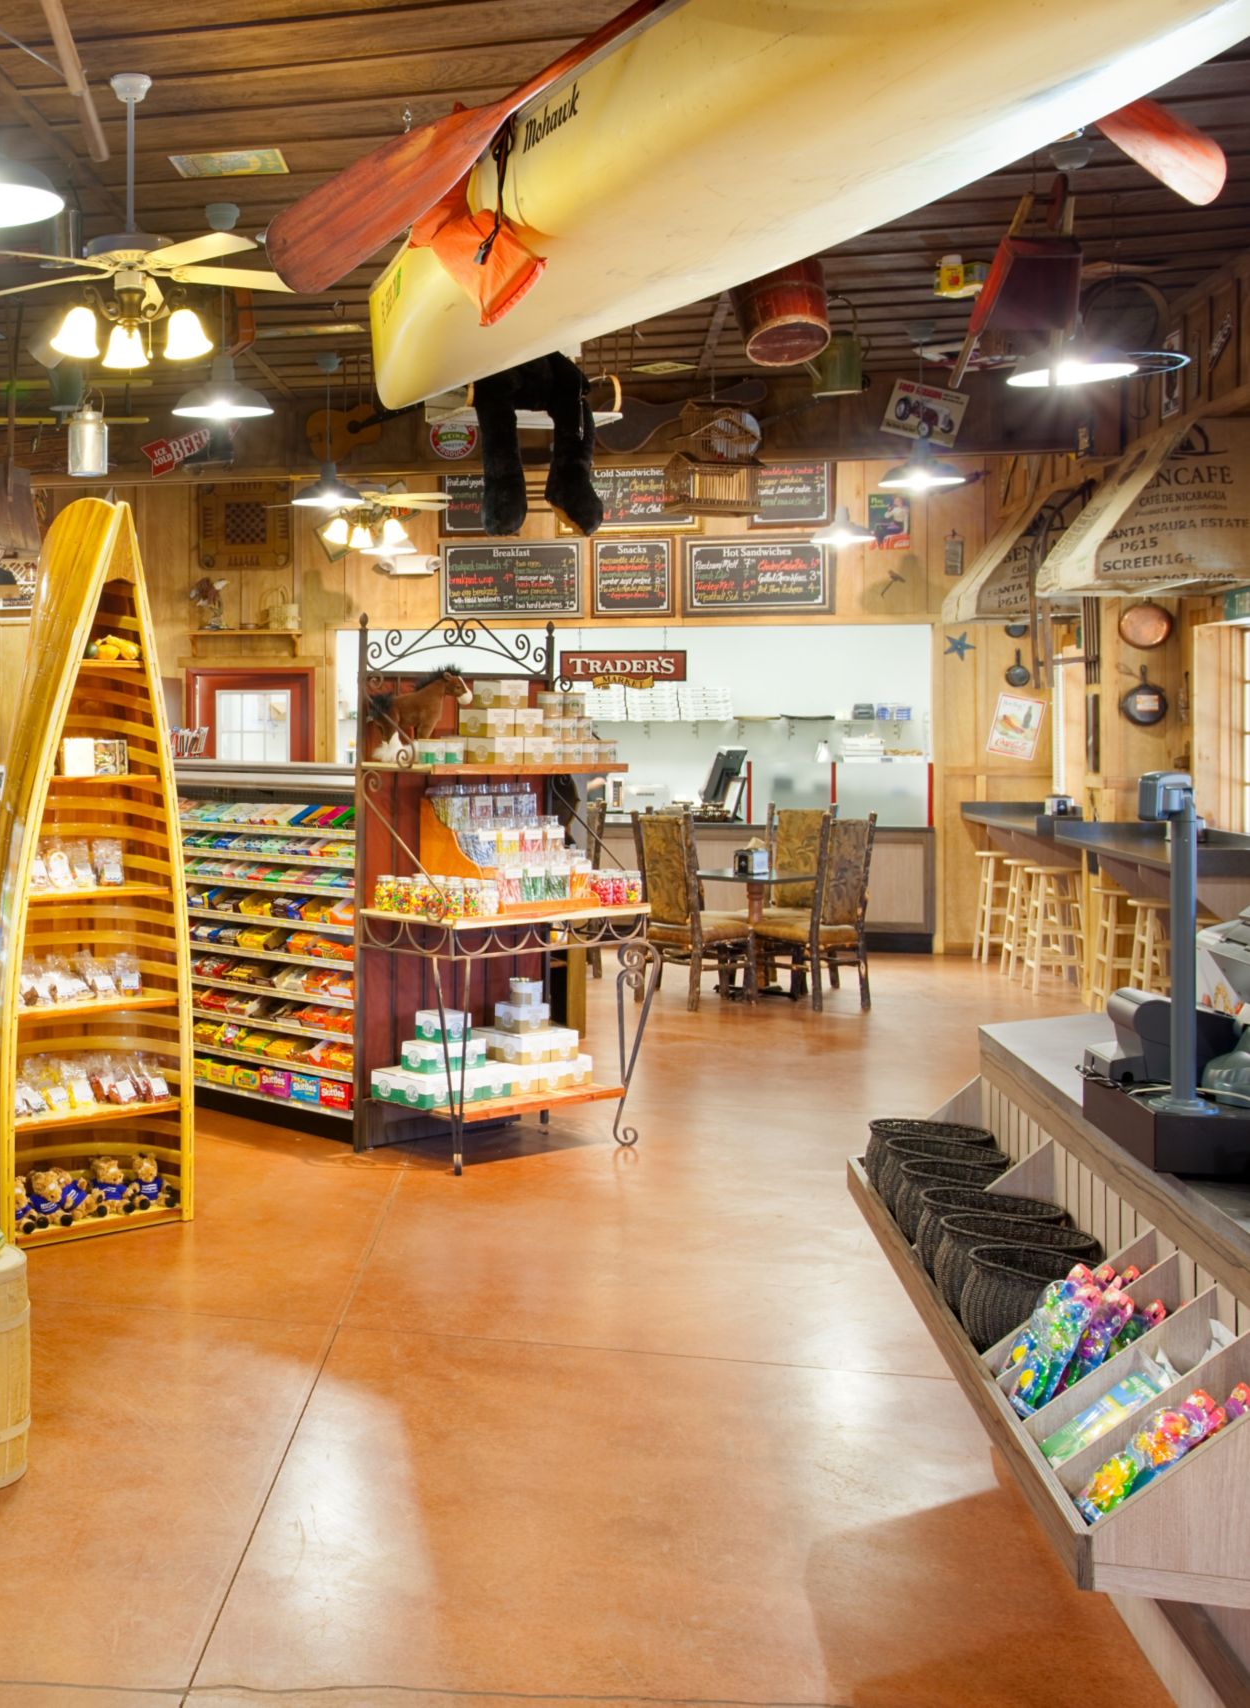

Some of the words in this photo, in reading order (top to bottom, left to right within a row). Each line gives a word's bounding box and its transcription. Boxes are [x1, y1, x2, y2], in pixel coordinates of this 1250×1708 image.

[523, 81, 579, 154] Mohawk
[153, 446, 168, 459] ICE
[153, 452, 173, 467] COLD
[594, 469, 614, 479] Cold
[1174, 489, 1227, 502] NICARAGUA
[1149, 519, 1197, 534] MAURA
[1201, 517, 1250, 529] ESTATE
[617, 545, 647, 555] Snacks
[1120, 537, 1159, 553] P615
[492, 549, 531, 558] Breakfast
[722, 549, 739, 557] Hot
[740, 547, 792, 557] Sandwiches
[1102, 555, 1164, 572] SCREEN
[569, 656, 675, 675] TRADER'S
[602, 675, 644, 687] MARKET
[261, 1074, 286, 1086] Skittles
[292, 1082, 317, 1093] Skittles
[321, 1088, 345, 1098] Skittles
